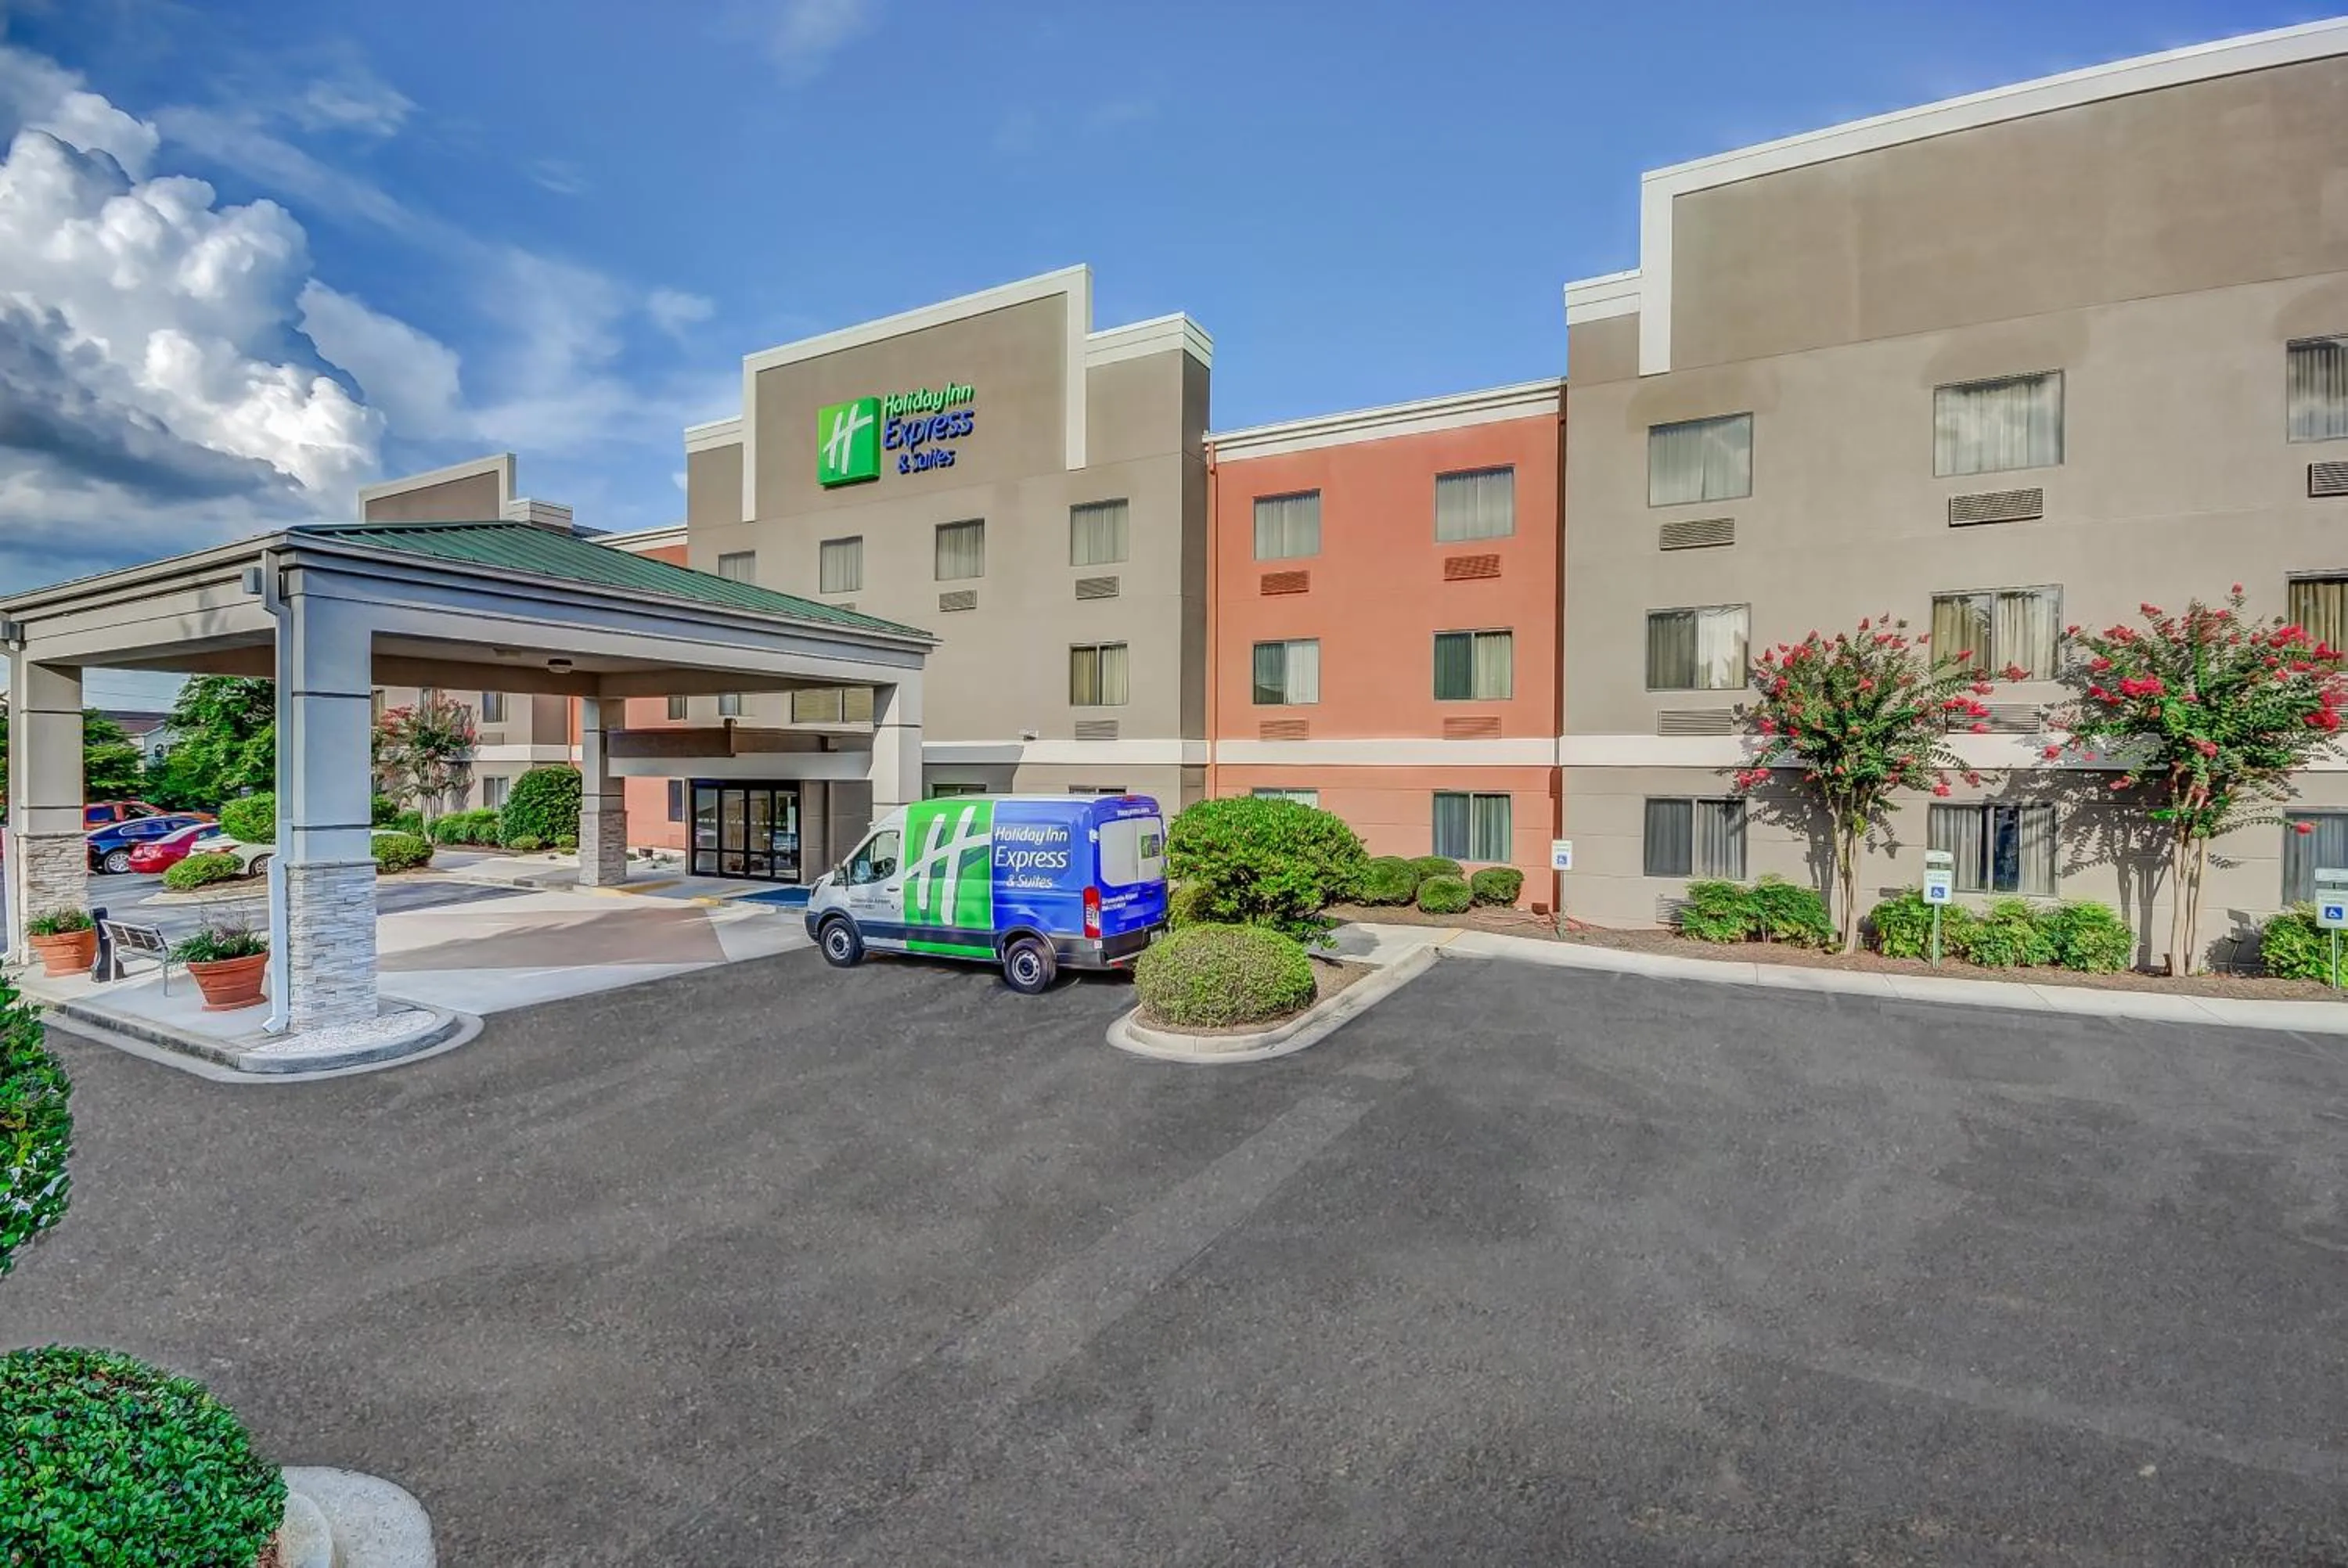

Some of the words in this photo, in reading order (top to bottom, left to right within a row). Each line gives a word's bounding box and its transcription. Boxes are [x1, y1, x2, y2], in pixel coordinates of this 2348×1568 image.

[884, 387, 944, 419] Holiday
[945, 382, 974, 406] Inn
[883, 409, 974, 452] Express
[898, 454, 910, 474] &
[911, 448, 956, 473] Suites
[995, 826, 1044, 845] Holiday
[1046, 826, 1068, 842] Inn
[995, 846, 1068, 872] Express
[1006, 874, 1015, 886] &
[1017, 874, 1053, 888] Suites
